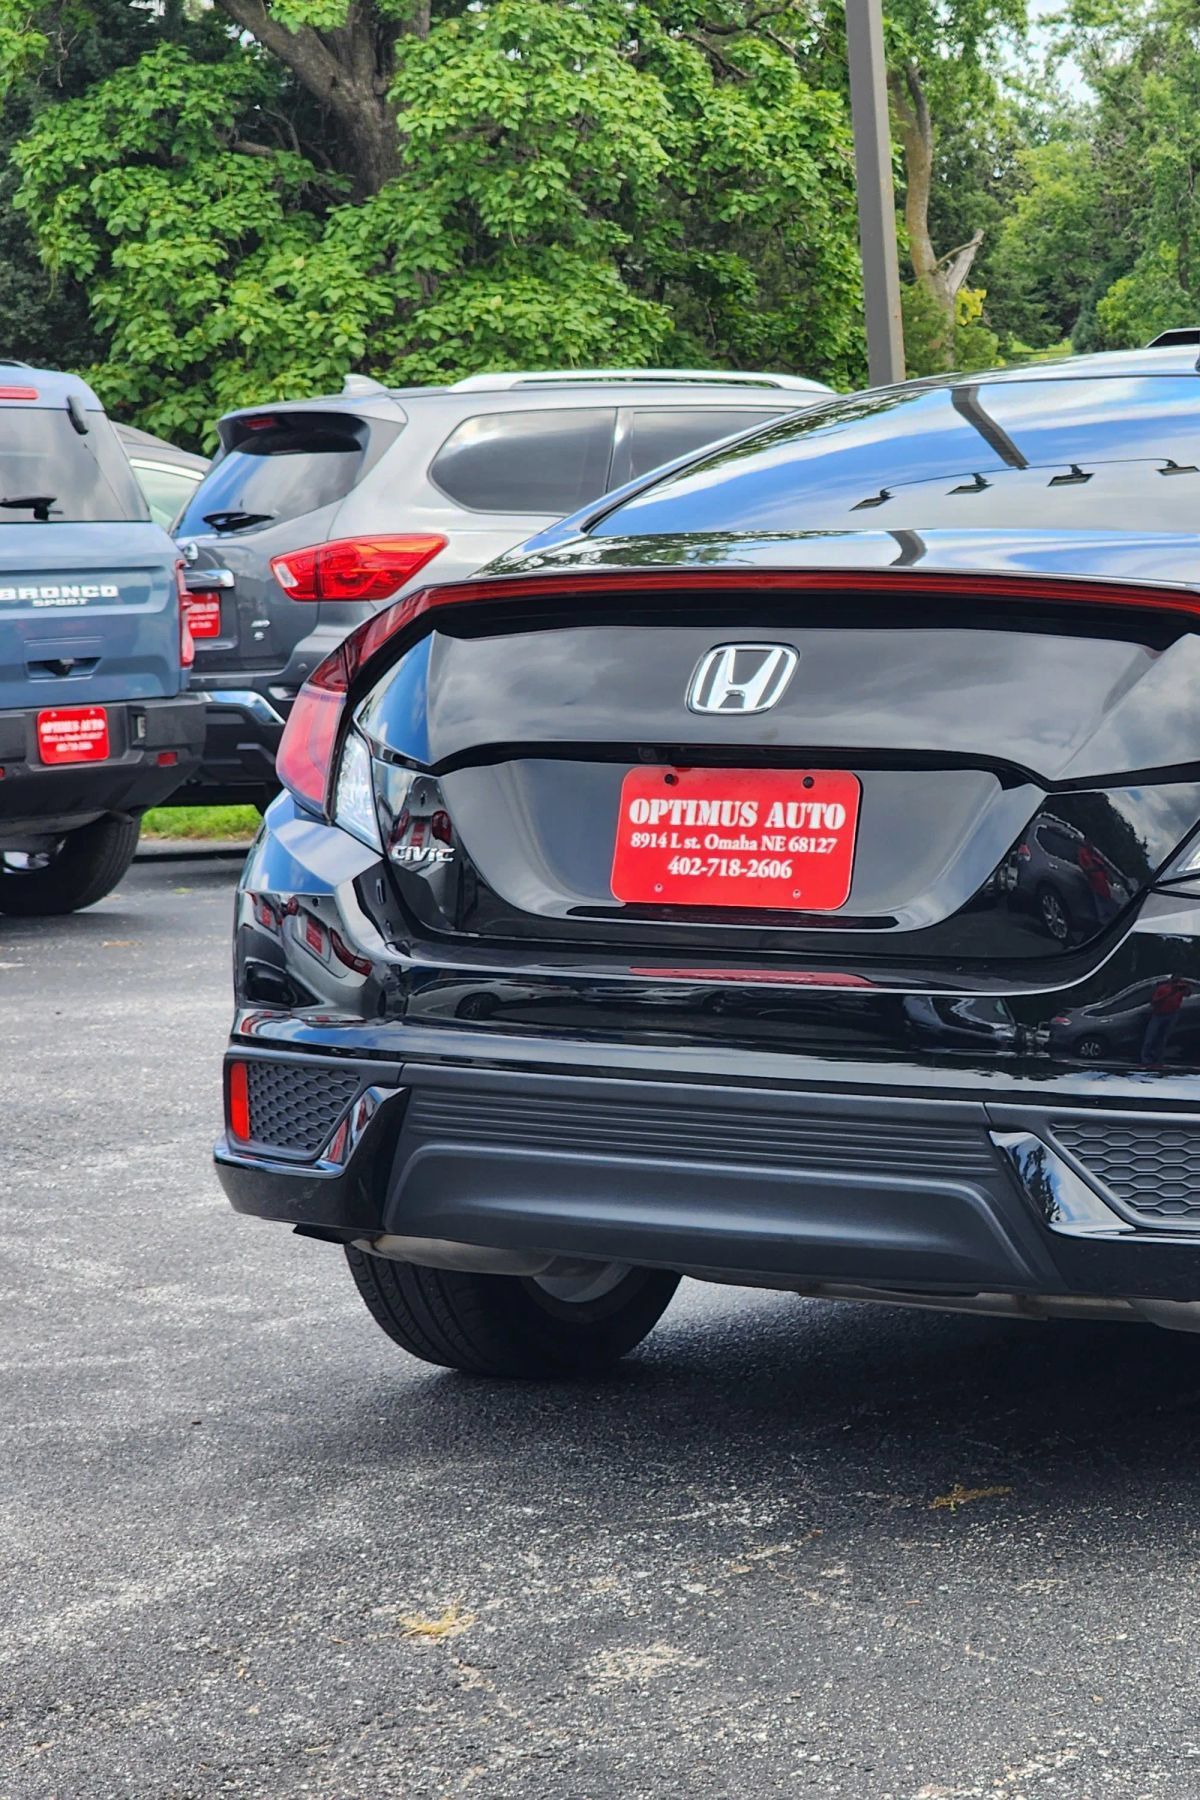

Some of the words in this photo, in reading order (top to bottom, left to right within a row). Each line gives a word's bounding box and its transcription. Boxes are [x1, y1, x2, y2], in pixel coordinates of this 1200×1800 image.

[0, 586, 118, 600] BRONCO
[32, 598, 87, 607] SPORT
[629, 798, 758, 828] OPTIMUS
[765, 802, 846, 830] AUTO
[630, 832, 668, 848] 8914
[670, 833, 682, 849] L
[684, 835, 701, 849] st.
[704, 834, 757, 851] Omaha
[760, 835, 786, 852] NE
[788, 837, 838, 854] 68127
[391, 845, 455, 862] CIVIC
[667, 856, 792, 879] 402-718-2606
